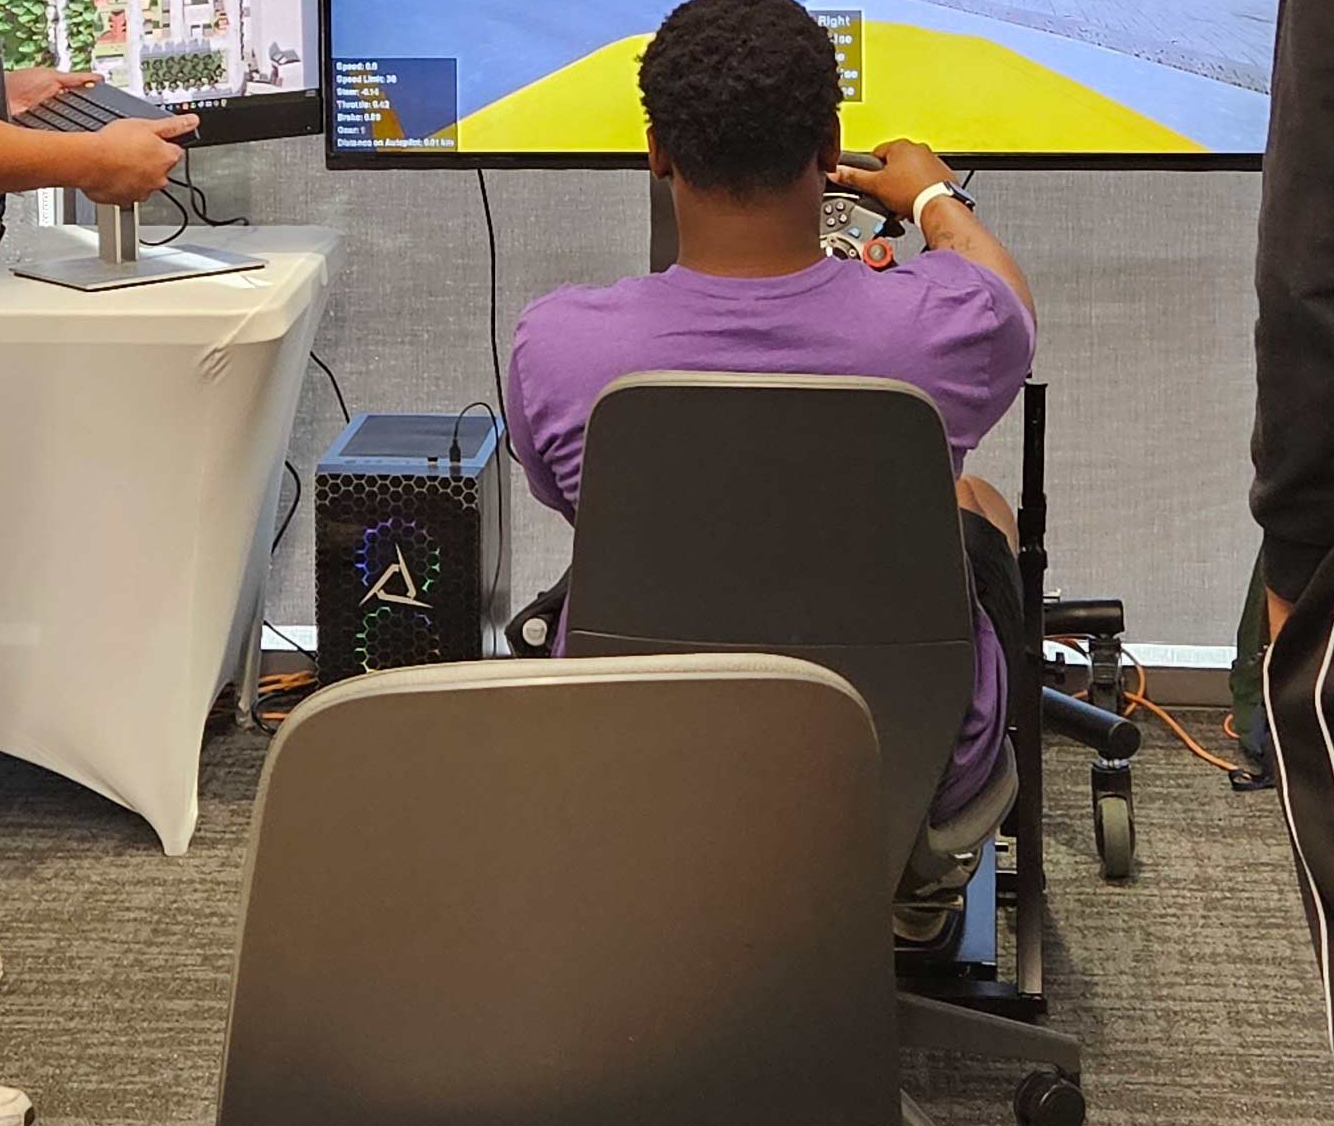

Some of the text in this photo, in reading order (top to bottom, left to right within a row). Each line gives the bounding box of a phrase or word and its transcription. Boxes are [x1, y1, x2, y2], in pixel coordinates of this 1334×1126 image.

[336, 75, 362, 85] Speed
[337, 138, 373, 148] Distance
[373, 139, 384, 147] on
[440, 137, 455, 147] km
